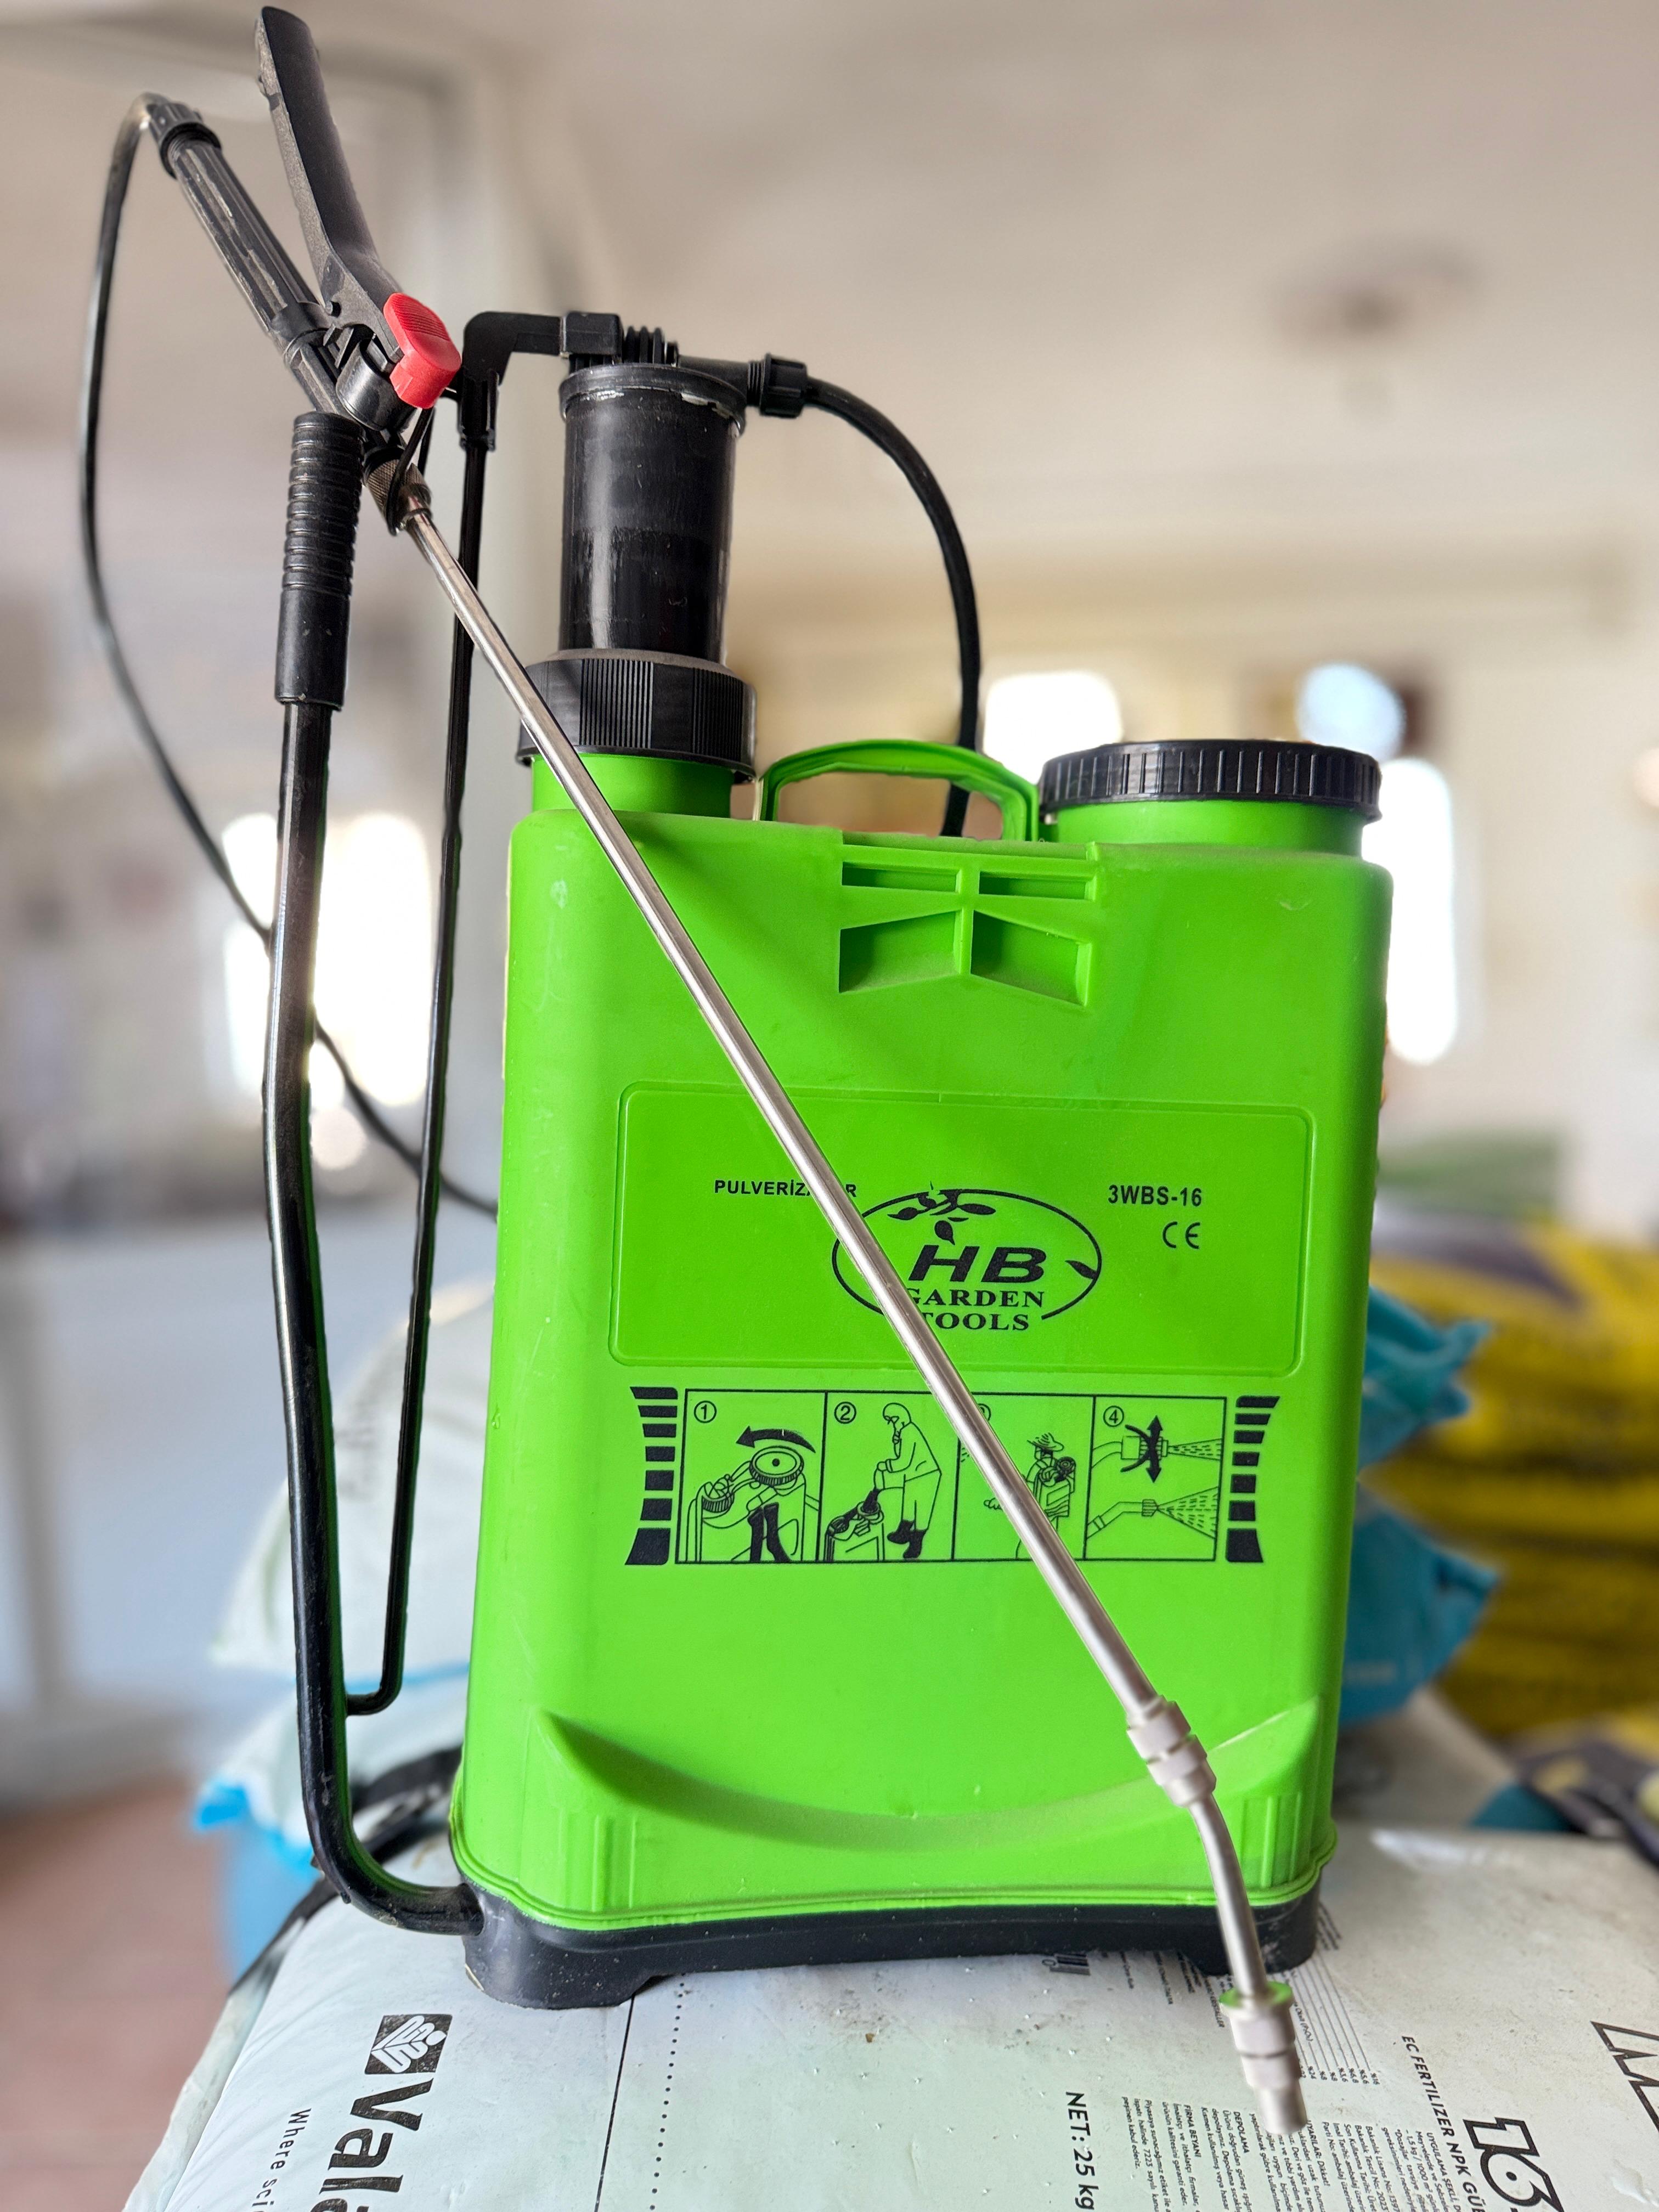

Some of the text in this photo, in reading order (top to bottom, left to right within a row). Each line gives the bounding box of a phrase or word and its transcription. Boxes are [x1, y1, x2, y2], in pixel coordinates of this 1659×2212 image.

[715, 1179, 857, 1198] PULVERİZR
[1108, 1184, 1202, 1207] 3WBS-16
[908, 1244, 1047, 1283] HB
[1401, 2036, 1419, 2052] EC
[1410, 2056, 1455, 2137] FERTILIZER
[1446, 2142, 1471, 2177] NPK
[1128, 2124, 1138, 2144] kabul
[1180, 2132, 1185, 2141] ve
[1233, 2111, 1250, 2153] DEPOLAMA
[1344, 2123, 1352, 2137] Son
[252, 2108, 312, 2212] Where sci
[1065, 2091, 1099, 2210] NET: 25 kg
[1143, 2148, 1153, 2168] 7223
[1172, 2160, 1186, 2186] garanti
[1272, 2155, 1283, 2179] uygun
